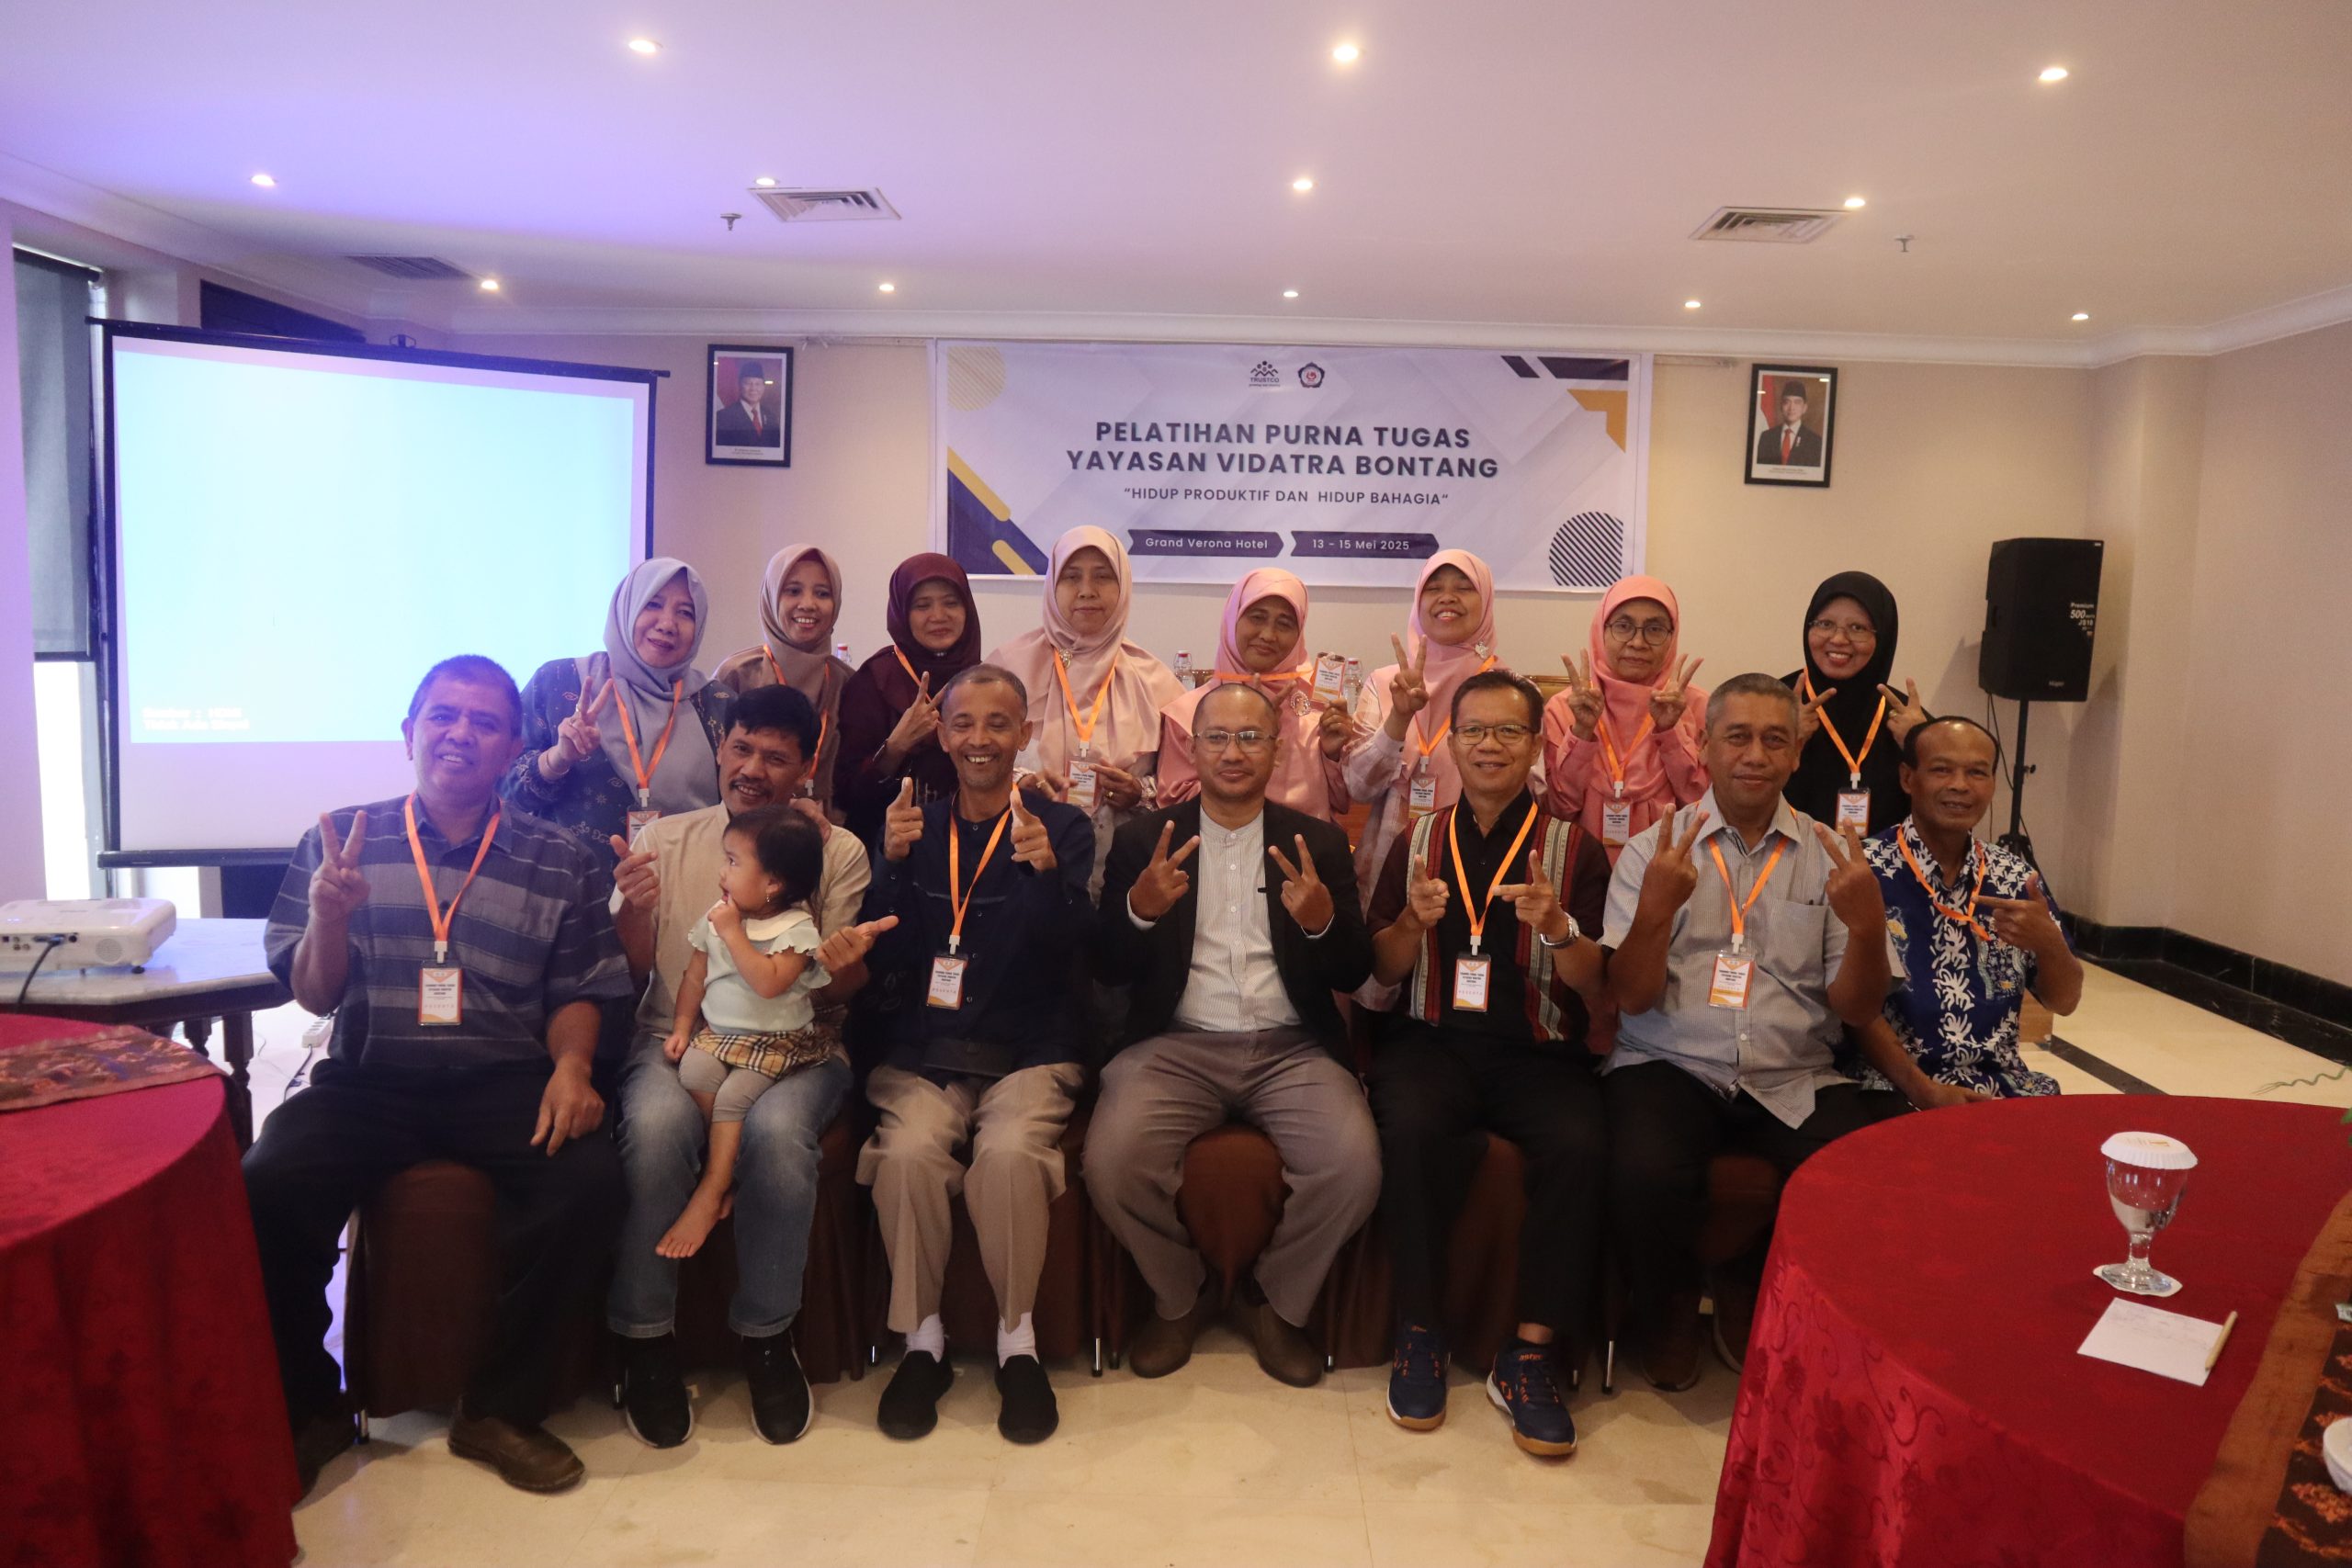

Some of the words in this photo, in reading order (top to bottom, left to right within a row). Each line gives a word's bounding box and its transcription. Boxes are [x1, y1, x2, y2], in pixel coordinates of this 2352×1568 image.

[1096, 422, 1254, 444] PELATIHAN
[1265, 424, 1363, 446] PURNA
[1373, 426, 1470, 448] TUGAS
[1067, 450, 1206, 472] YAYASAN
[1216, 452, 1345, 475] VIDATRA
[1355, 455, 1498, 479] BONTANG
[1184, 489, 1271, 502] PRODUKTIF
[1275, 490, 1308, 502] DAN
[1317, 491, 1365, 503] HIDUP
[1145, 537, 1183, 548] Grand
[1187, 538, 1232, 549] Verona
[1236, 539, 1268, 549] Hotel
[1312, 538, 1324, 549] 13
[1339, 539, 1351, 550] 15
[1355, 539, 1376, 550] Mei
[1380, 540, 1409, 551] 2025
[2070, 609, 2086, 619] 500
